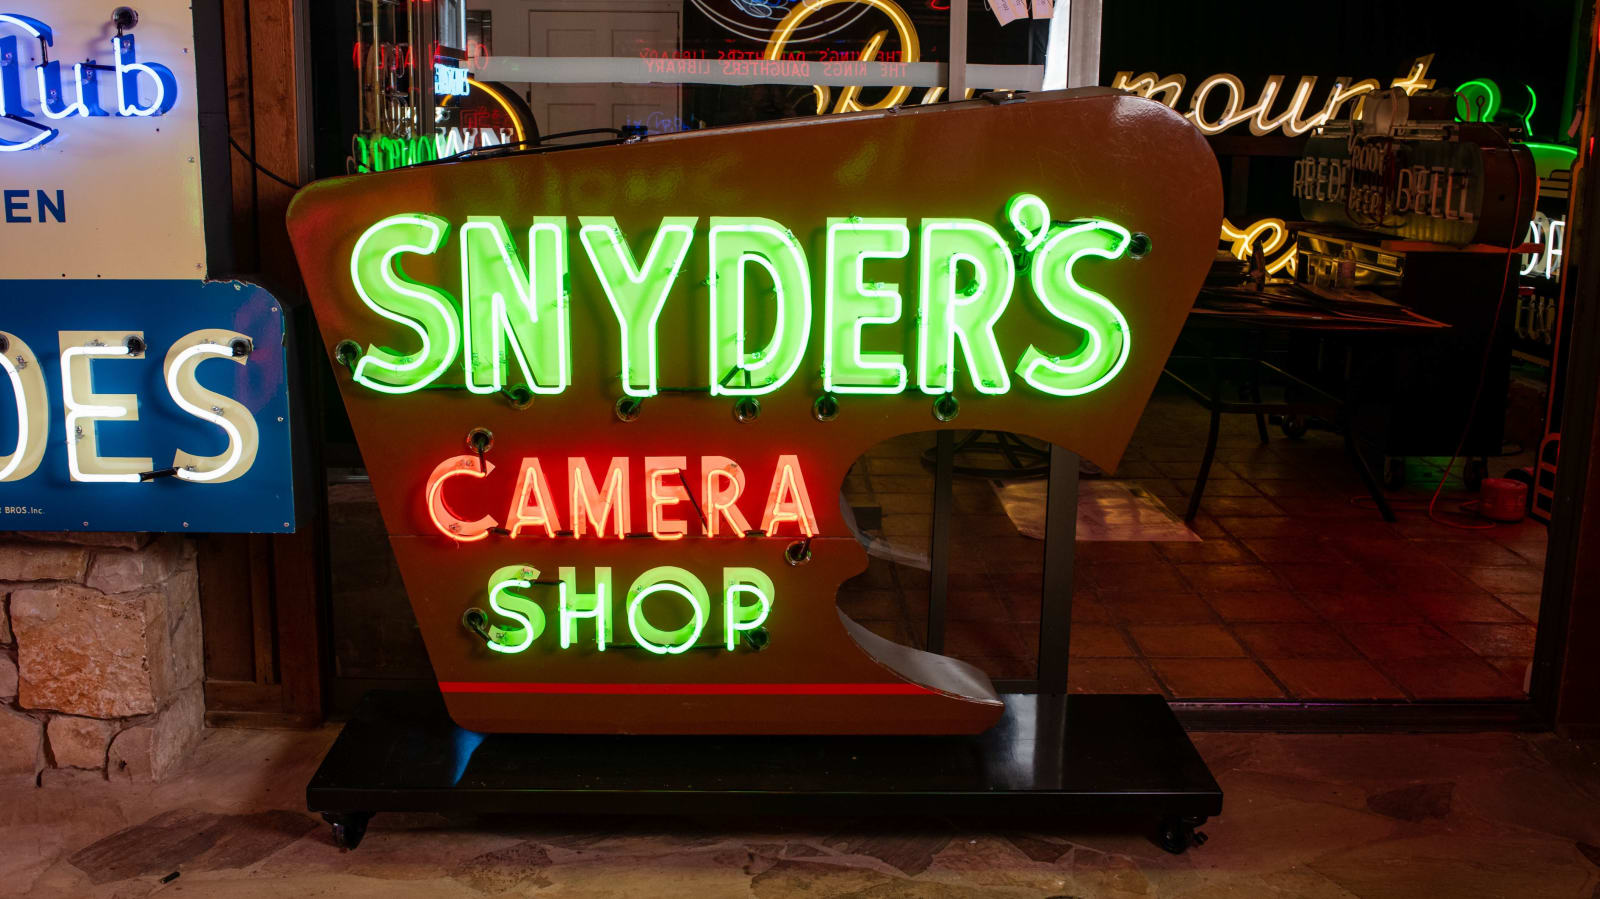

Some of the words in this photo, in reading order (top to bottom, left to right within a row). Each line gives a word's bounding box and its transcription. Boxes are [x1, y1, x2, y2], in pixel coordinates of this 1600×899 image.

[350, 193, 1131, 396] SNYDER'S
[426, 454, 820, 541] CAMERA
[487, 564, 775, 654] SHOP
